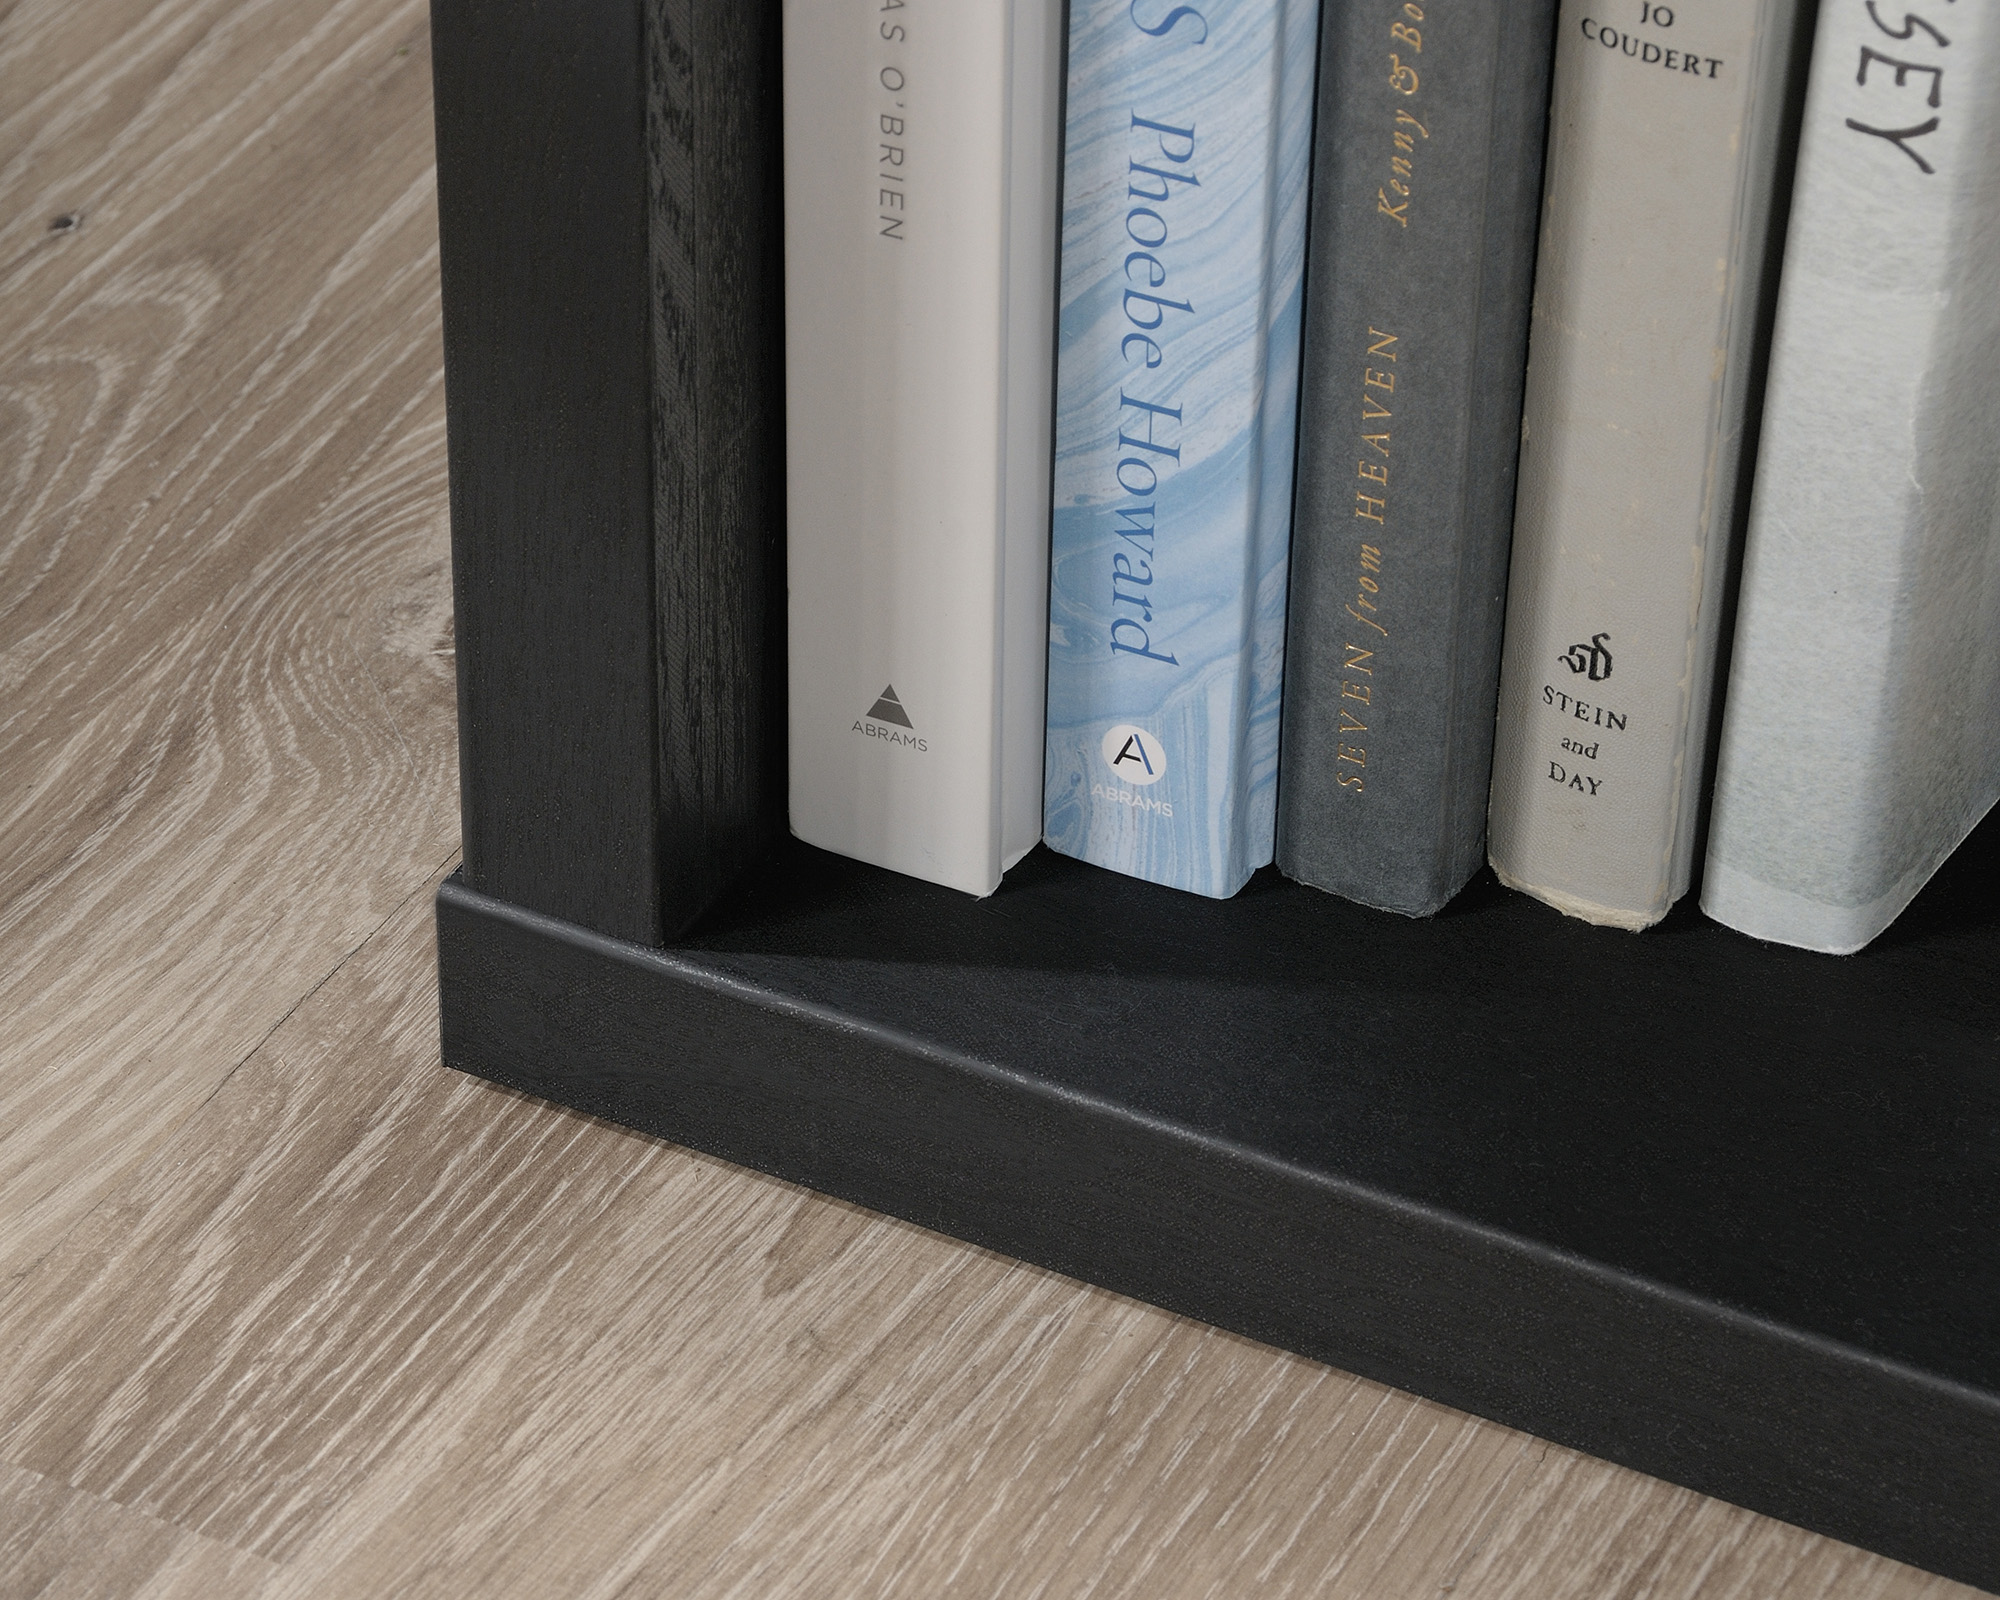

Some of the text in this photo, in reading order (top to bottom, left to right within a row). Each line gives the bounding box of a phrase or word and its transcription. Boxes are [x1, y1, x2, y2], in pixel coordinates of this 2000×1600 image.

[1391, 0, 1425, 54] Bo
[1640, 0, 1674, 28] JO
[1581, 17, 1724, 79] COUDERT
[1845, 0, 1952, 175] SEY
[879, 66, 906, 240] O'BRIEN
[1377, 108, 1430, 229] Kenny
[1109, 107, 1202, 667] Phoebe Howard
[1336, 326, 1399, 793] SEVEN from HEAVEN
[1542, 684, 1628, 731] STEIN
[851, 720, 928, 752] ABRAMS
[1560, 736, 1600, 760] and
[1091, 782, 1174, 817] ABRAMS
[1547, 760, 1603, 796] DAY
